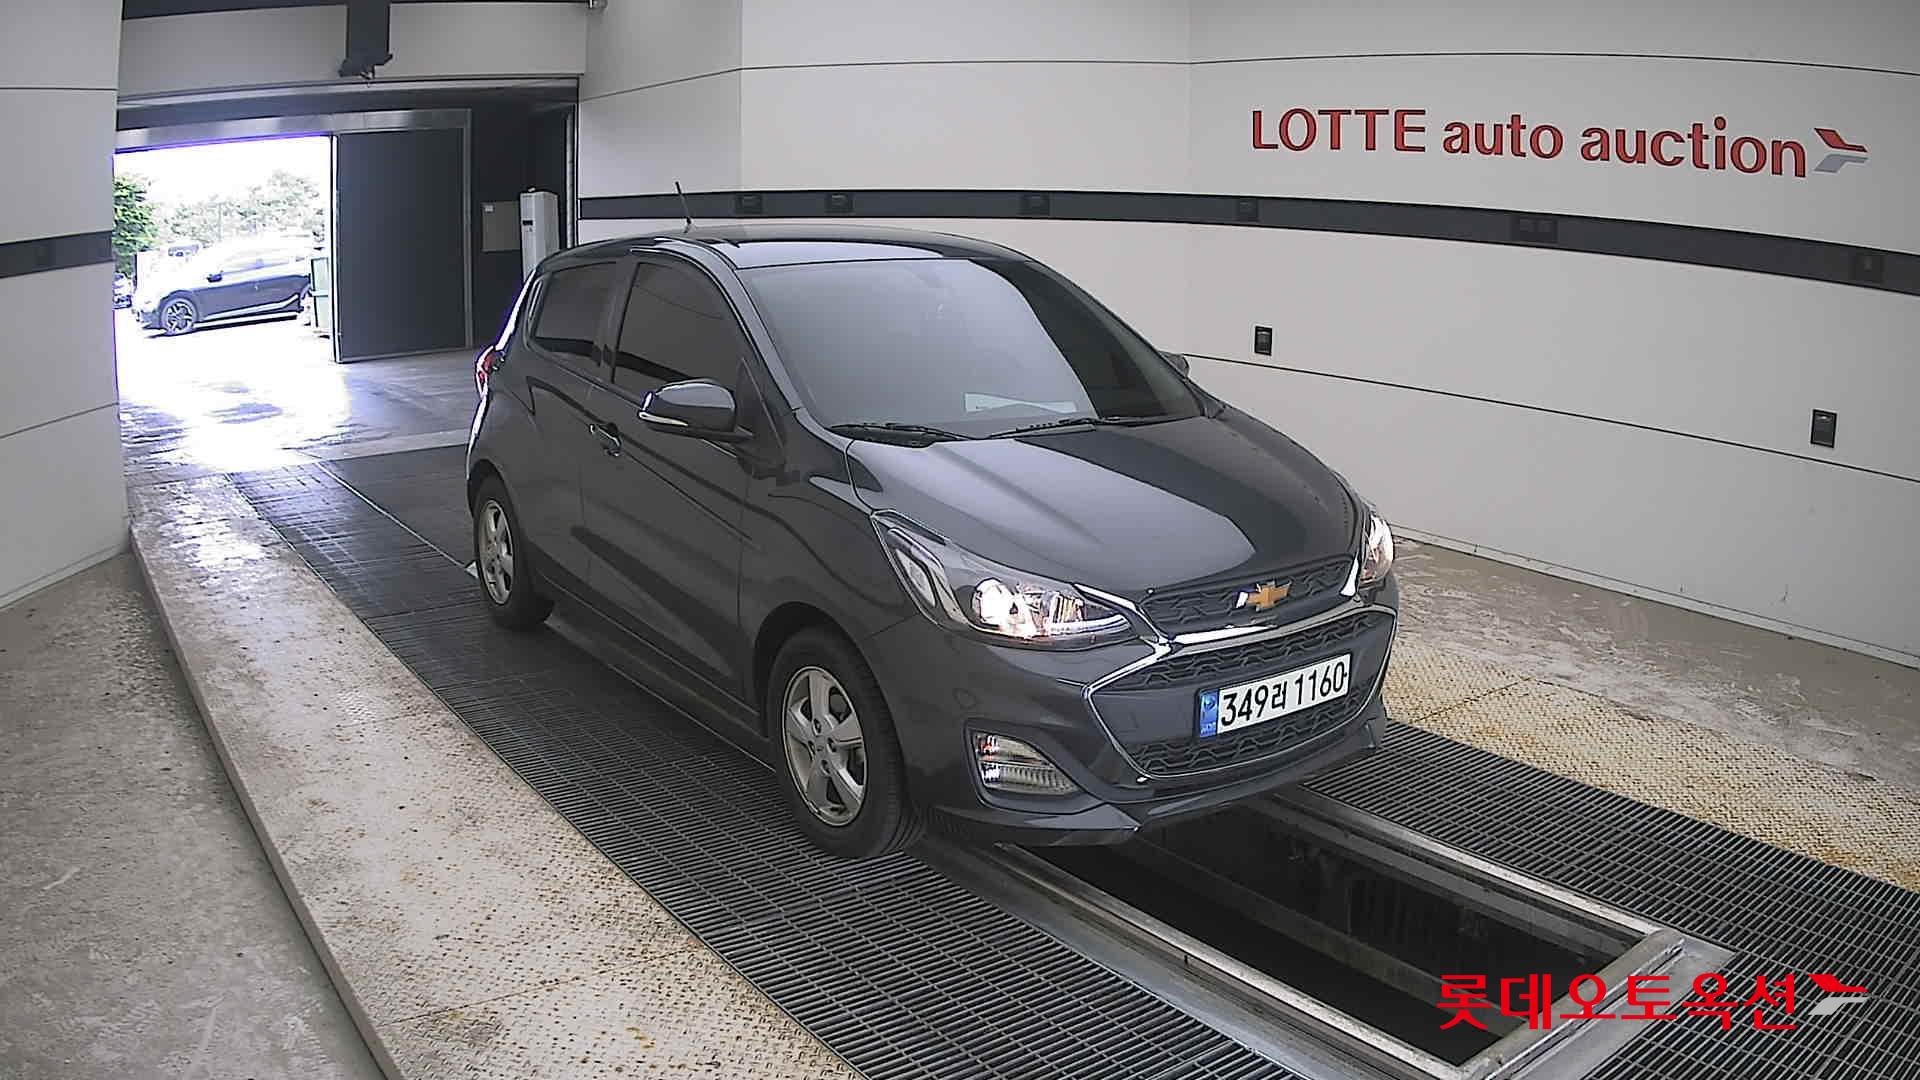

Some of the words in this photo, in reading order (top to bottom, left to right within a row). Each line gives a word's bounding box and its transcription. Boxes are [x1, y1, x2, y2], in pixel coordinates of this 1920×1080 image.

[1252, 109, 1426, 152] LOTTE
[1442, 114, 1564, 158] auto
[1580, 116, 1806, 177] auction
[1221, 681, 1288, 727] 349러
[1294, 661, 1346, 705] 1160
